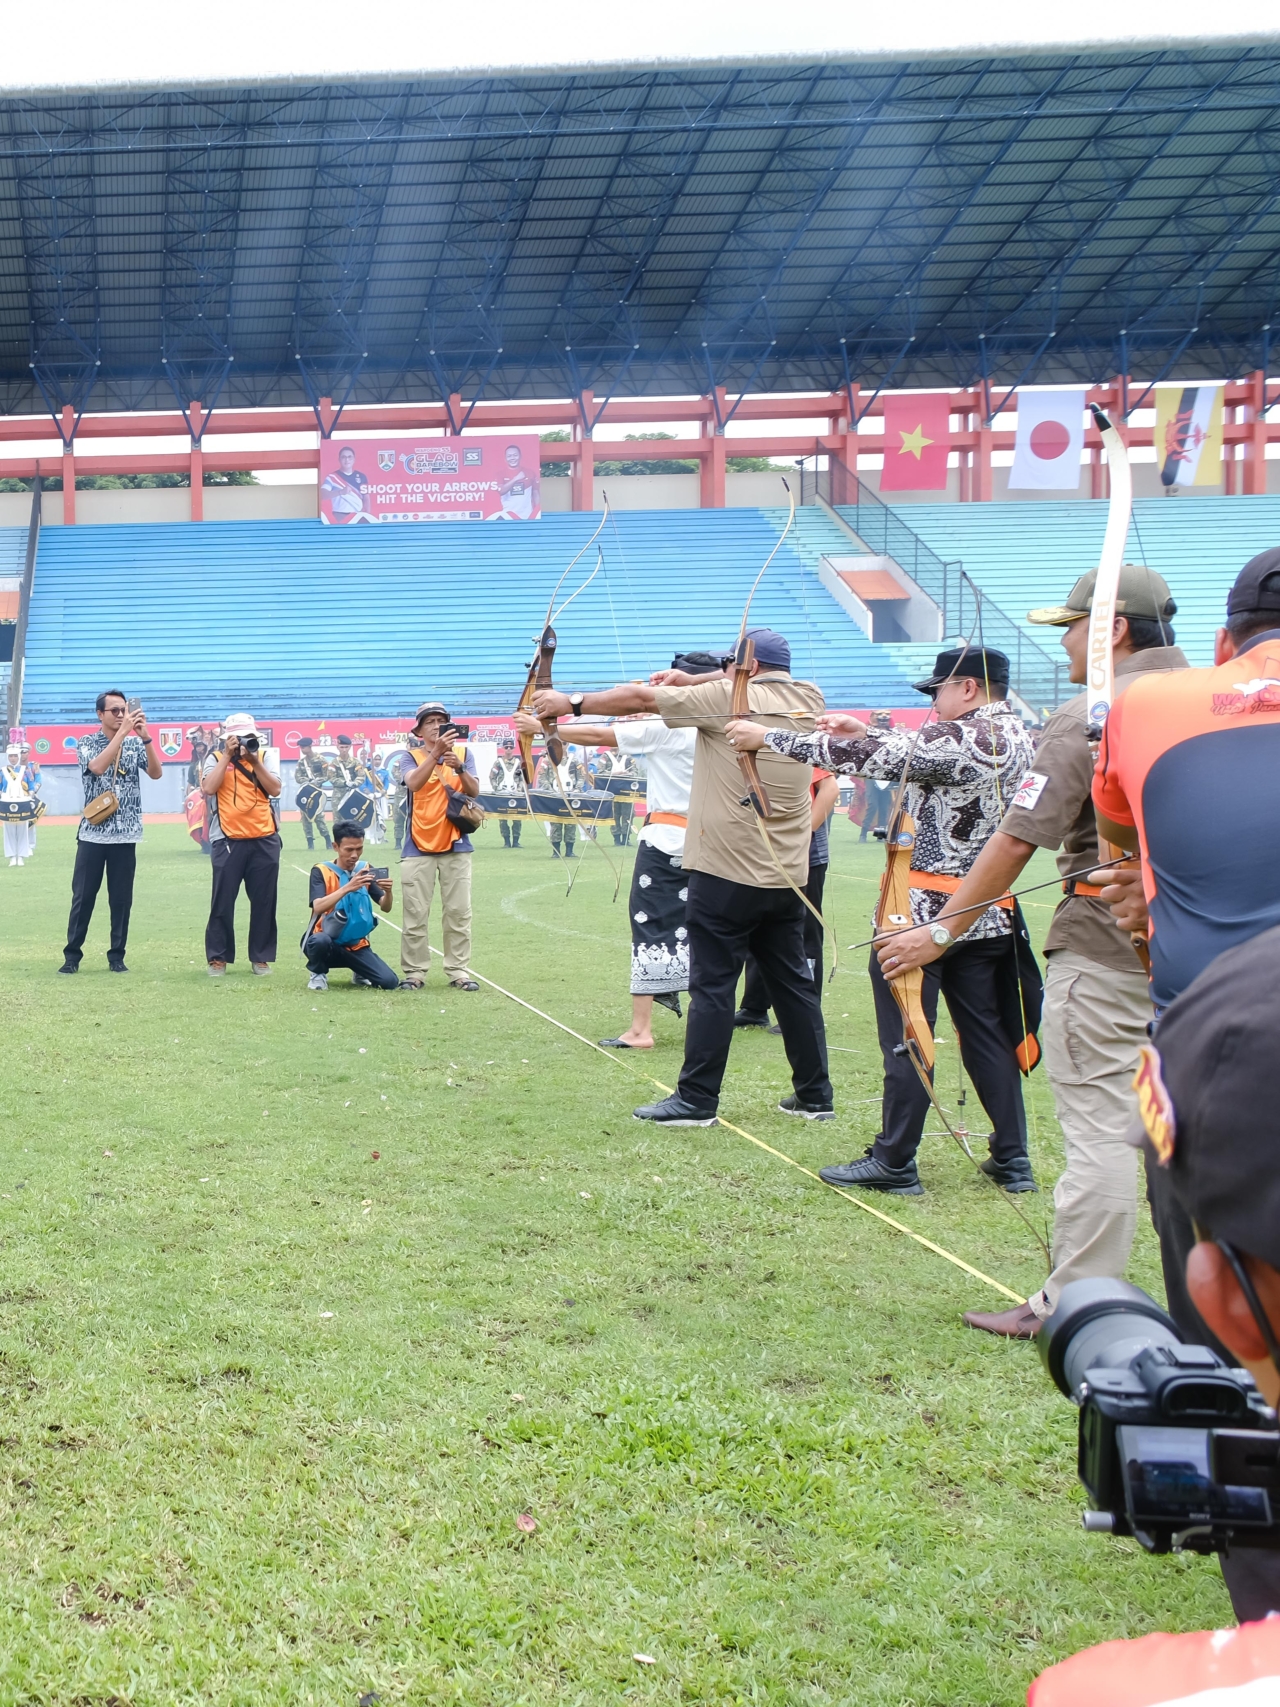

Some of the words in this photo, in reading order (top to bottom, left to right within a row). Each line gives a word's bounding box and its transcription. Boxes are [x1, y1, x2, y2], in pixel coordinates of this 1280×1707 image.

[415, 453, 458, 462] GLADI
[360, 483, 402, 494] SHOOT
[405, 482, 440, 493] YOUR
[443, 481, 502, 492] ARROWS,
[376, 494, 399, 504] HIT
[400, 493, 424, 503] THE
[428, 492, 485, 503] VICTORY!
[1091, 592, 1112, 691] CARTEL
[396, 733, 408, 743] 24
[477, 730, 515, 738] GLADI
[320, 736, 332, 746] 23
